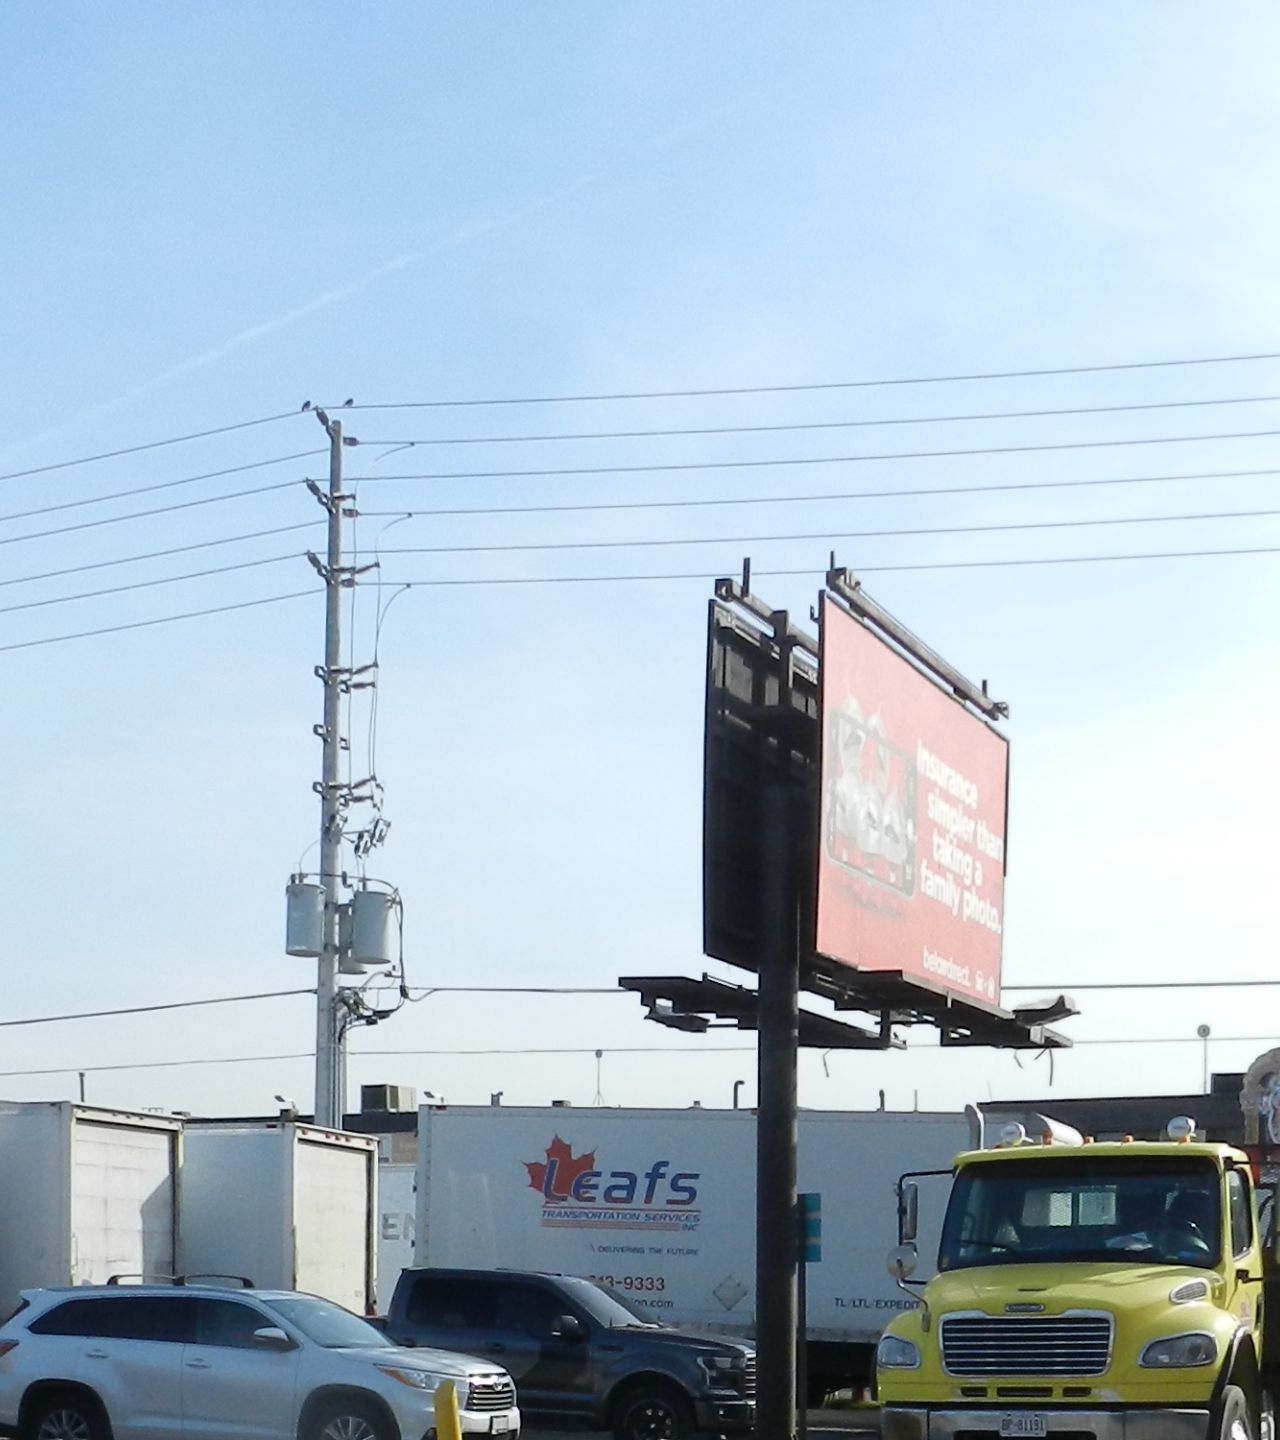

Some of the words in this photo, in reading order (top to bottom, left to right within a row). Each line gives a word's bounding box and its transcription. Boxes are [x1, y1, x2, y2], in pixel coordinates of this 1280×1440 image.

[928, 789, 975, 842] simpler
[977, 818, 1003, 864] than
[933, 828, 973, 886] taking
[974, 861, 983, 887] a
[920, 858, 961, 916] family
[543, 1159, 701, 1206] Leafs
[542, 1210, 639, 1221] TRANSPORTATION
[644, 1212, 701, 1222] SERVICES
